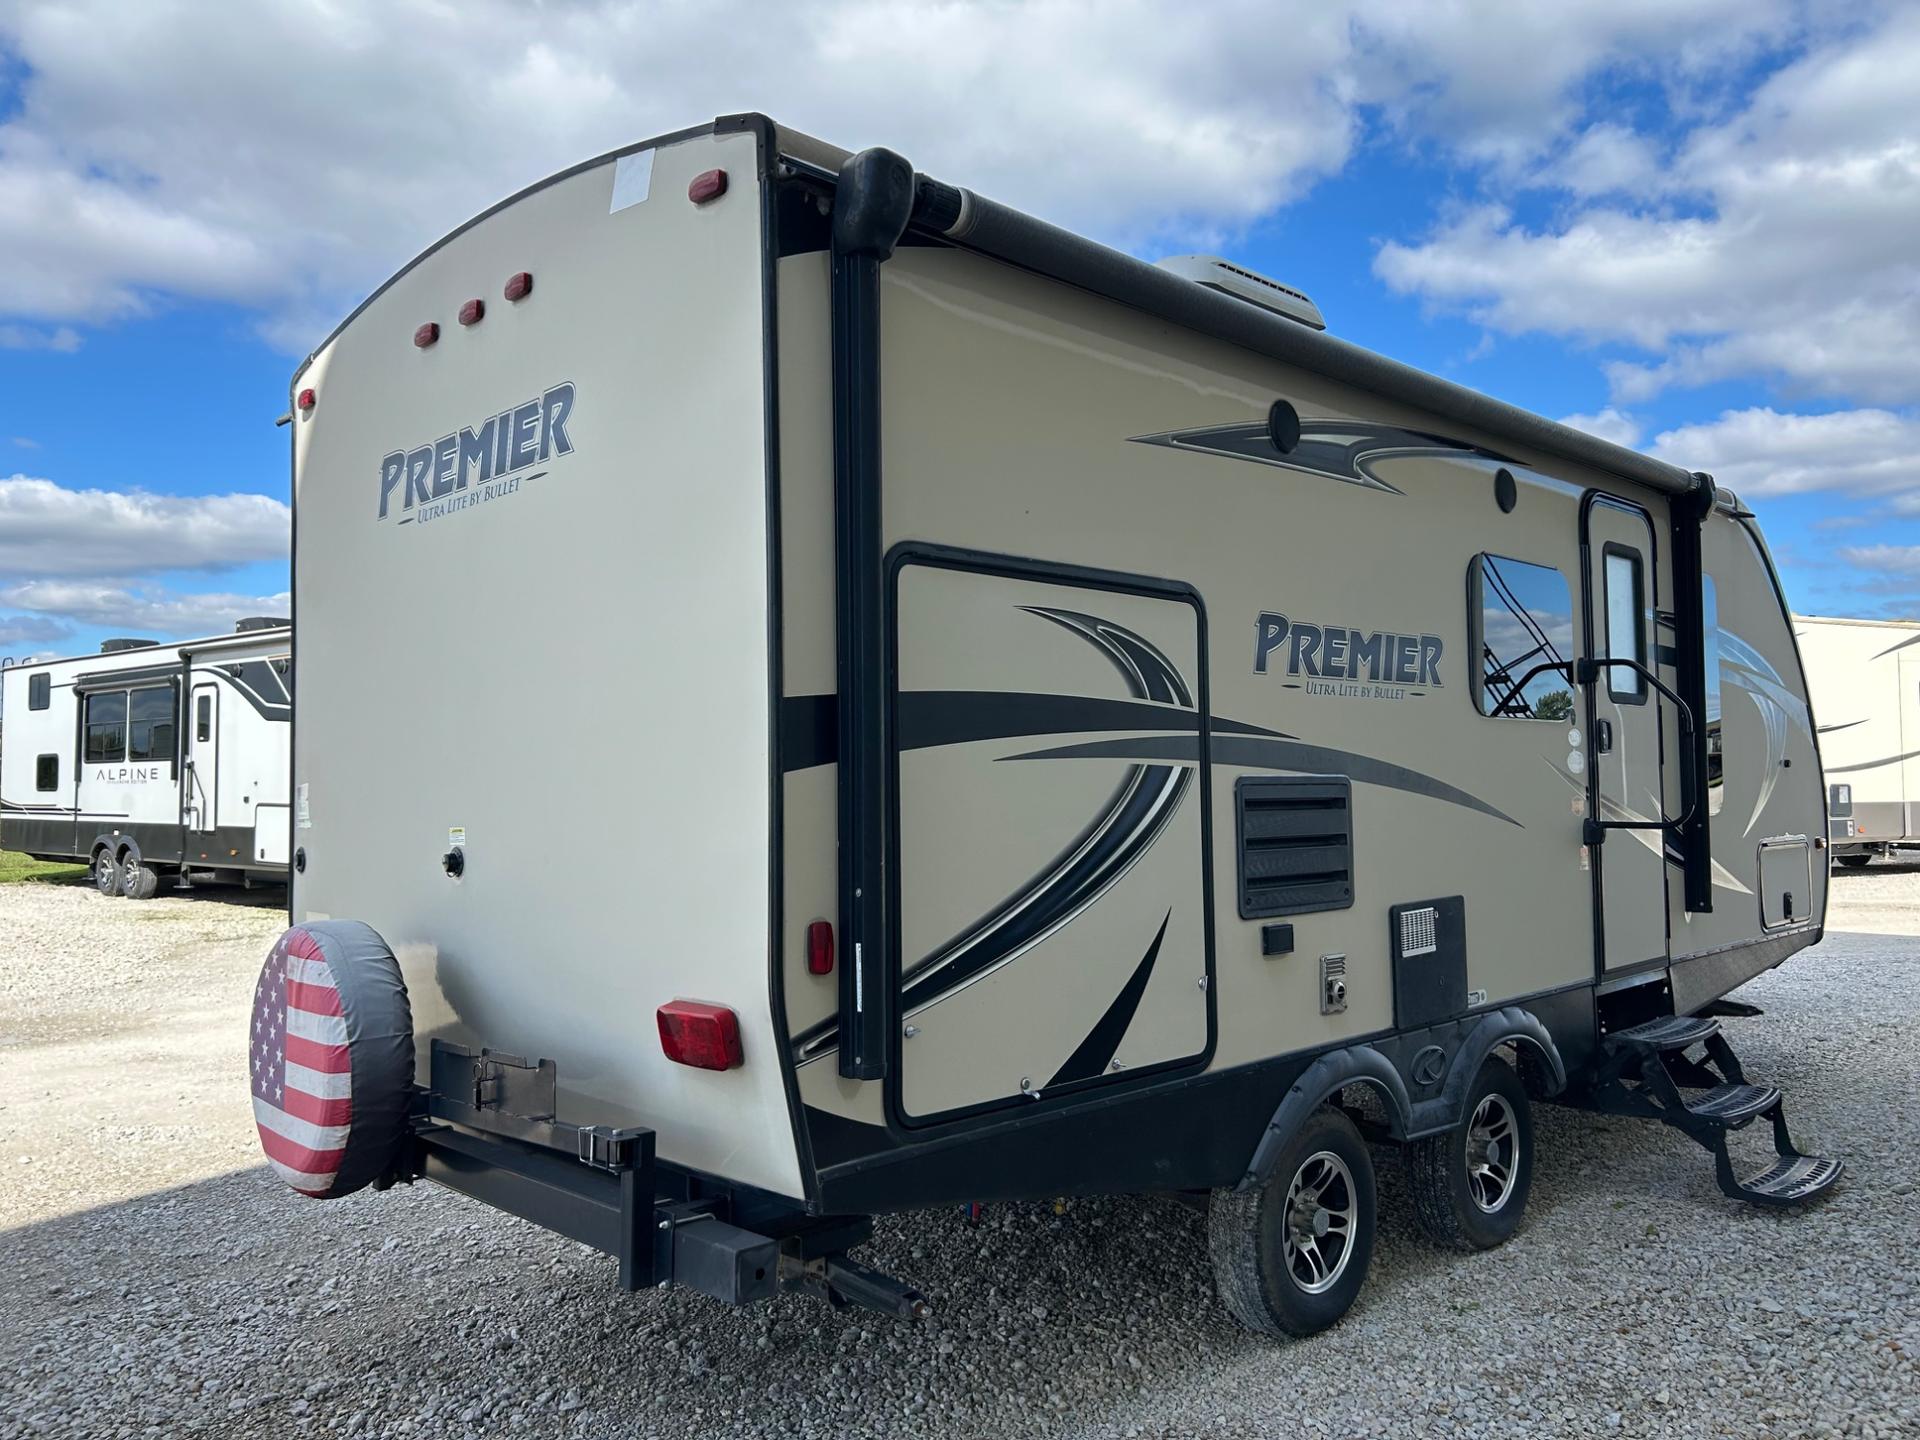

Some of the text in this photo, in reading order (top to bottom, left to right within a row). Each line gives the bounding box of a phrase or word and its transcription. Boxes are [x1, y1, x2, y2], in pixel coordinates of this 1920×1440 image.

[378, 381, 576, 520] PREMIER
[417, 477, 521, 524] ULTRA LITE BY BULLET
[1253, 610, 1445, 688] PREMIER
[1306, 681, 1406, 700] ULTRA LITE BY BULLET
[97, 768, 158, 781] ALPINE
